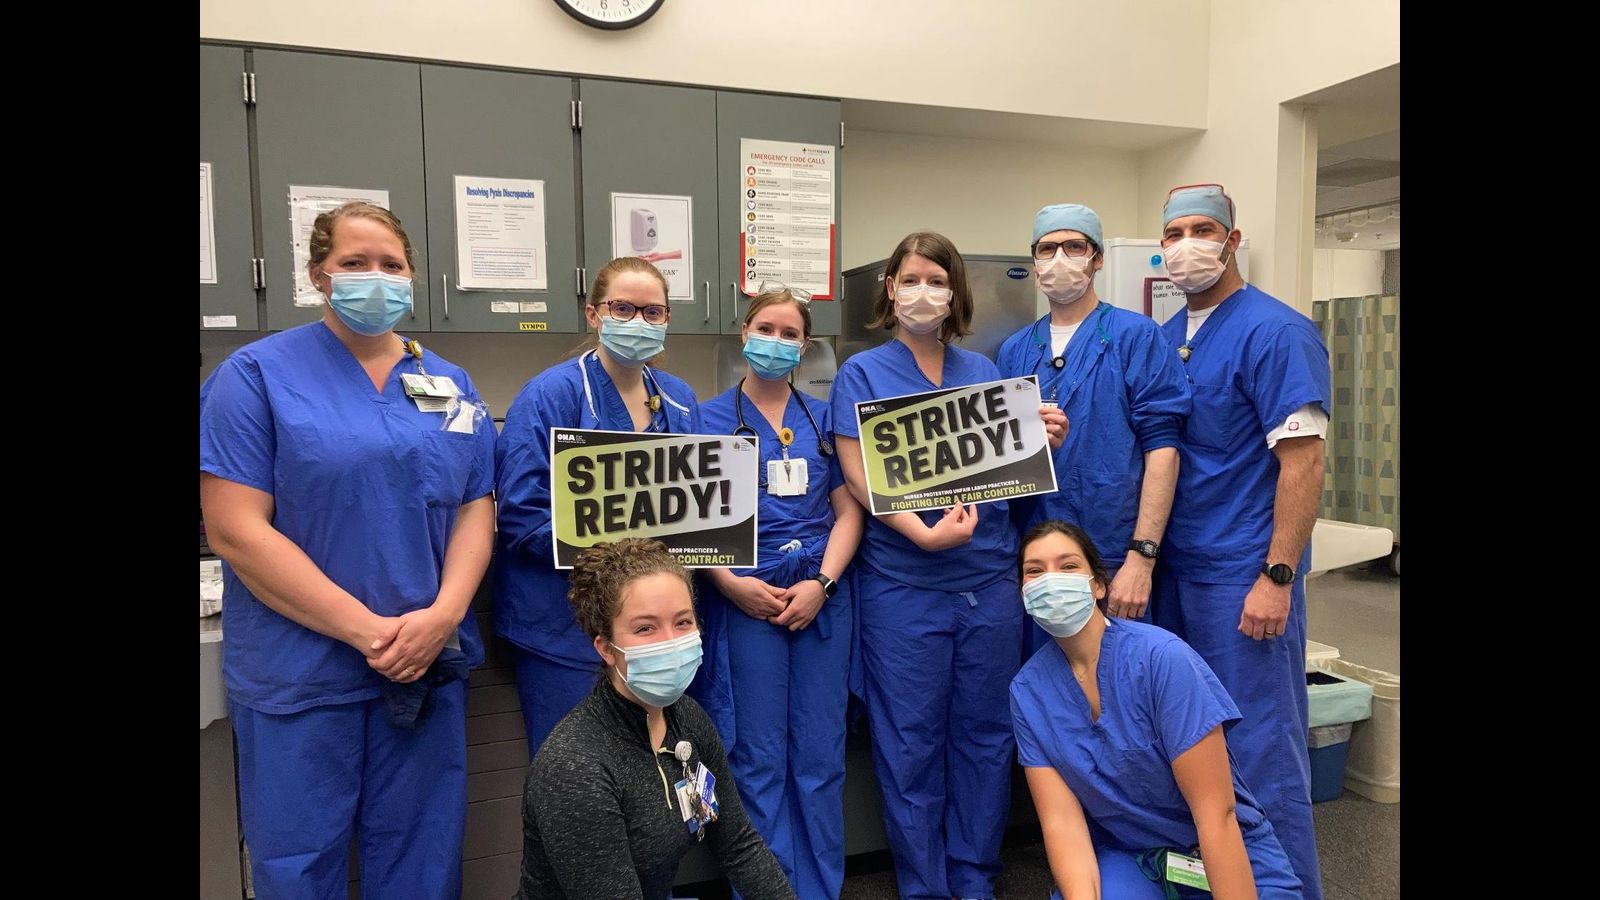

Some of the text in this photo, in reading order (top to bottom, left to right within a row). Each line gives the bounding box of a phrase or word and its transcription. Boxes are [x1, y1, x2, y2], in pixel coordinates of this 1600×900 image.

[750, 152, 826, 165] EMERGENCY CODE CALLS
[466, 186, 535, 200] Resolving Pyxis Discrepancies
[860, 405, 877, 413] ONA
[873, 385, 1008, 454] STRIKE
[557, 433, 576, 442] ONA
[883, 418, 1023, 489] READY!
[567, 440, 722, 494] STRIKE
[891, 483, 1037, 511] FIGHTING FOR A FAIR CONTRACT!
[923, 489, 953, 498] PROTESTING
[953, 487, 971, 495] UNFAIR
[971, 484, 988, 492] LABOR
[987, 480, 1015, 489] PRACTICES
[574, 479, 731, 537] READY!
[677, 554, 735, 564] CONTRACT!
